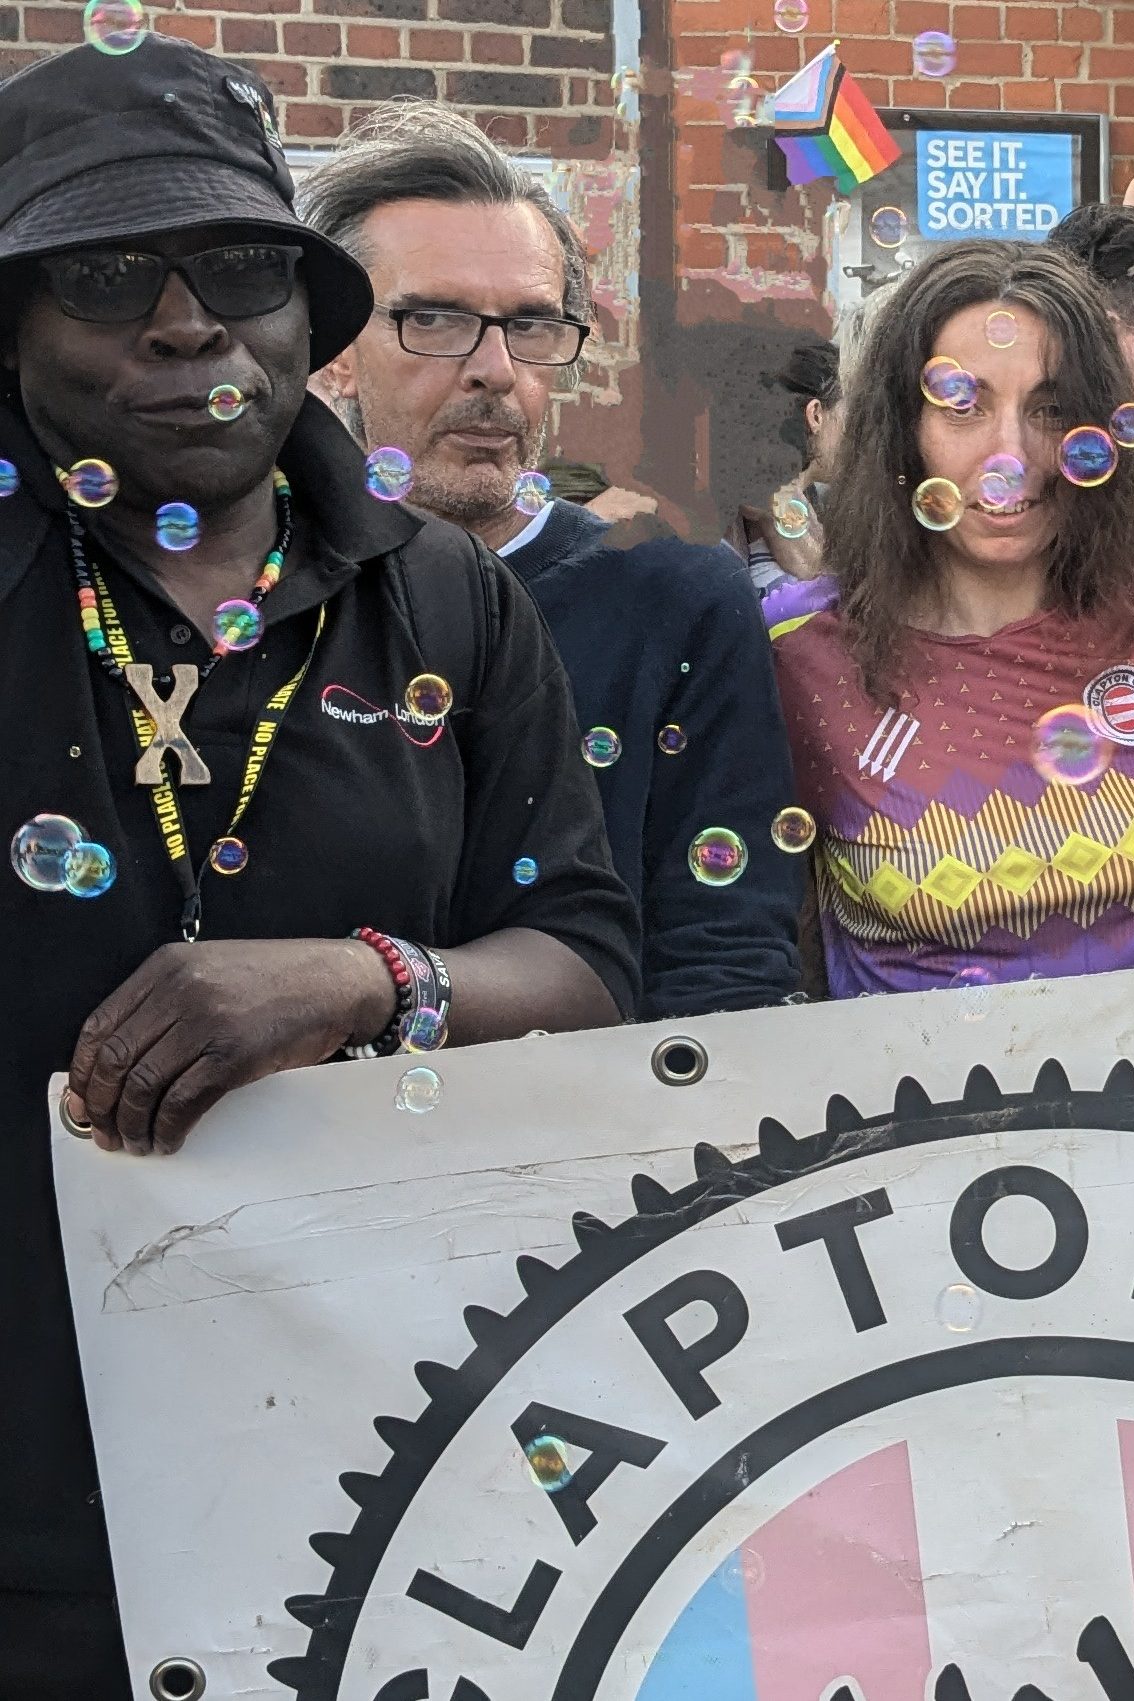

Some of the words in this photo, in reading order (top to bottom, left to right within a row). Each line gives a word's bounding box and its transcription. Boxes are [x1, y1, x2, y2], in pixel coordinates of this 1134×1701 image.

[927, 139, 986, 168] SEE
[993, 141, 1027, 169] IT.
[927, 170, 988, 200] SAY
[993, 172, 1027, 200] IT.
[321, 697, 389, 725] Newham
[254, 720, 278, 743] NO
[241, 744, 268, 795] PLACE
[166, 833, 187, 861] NO
